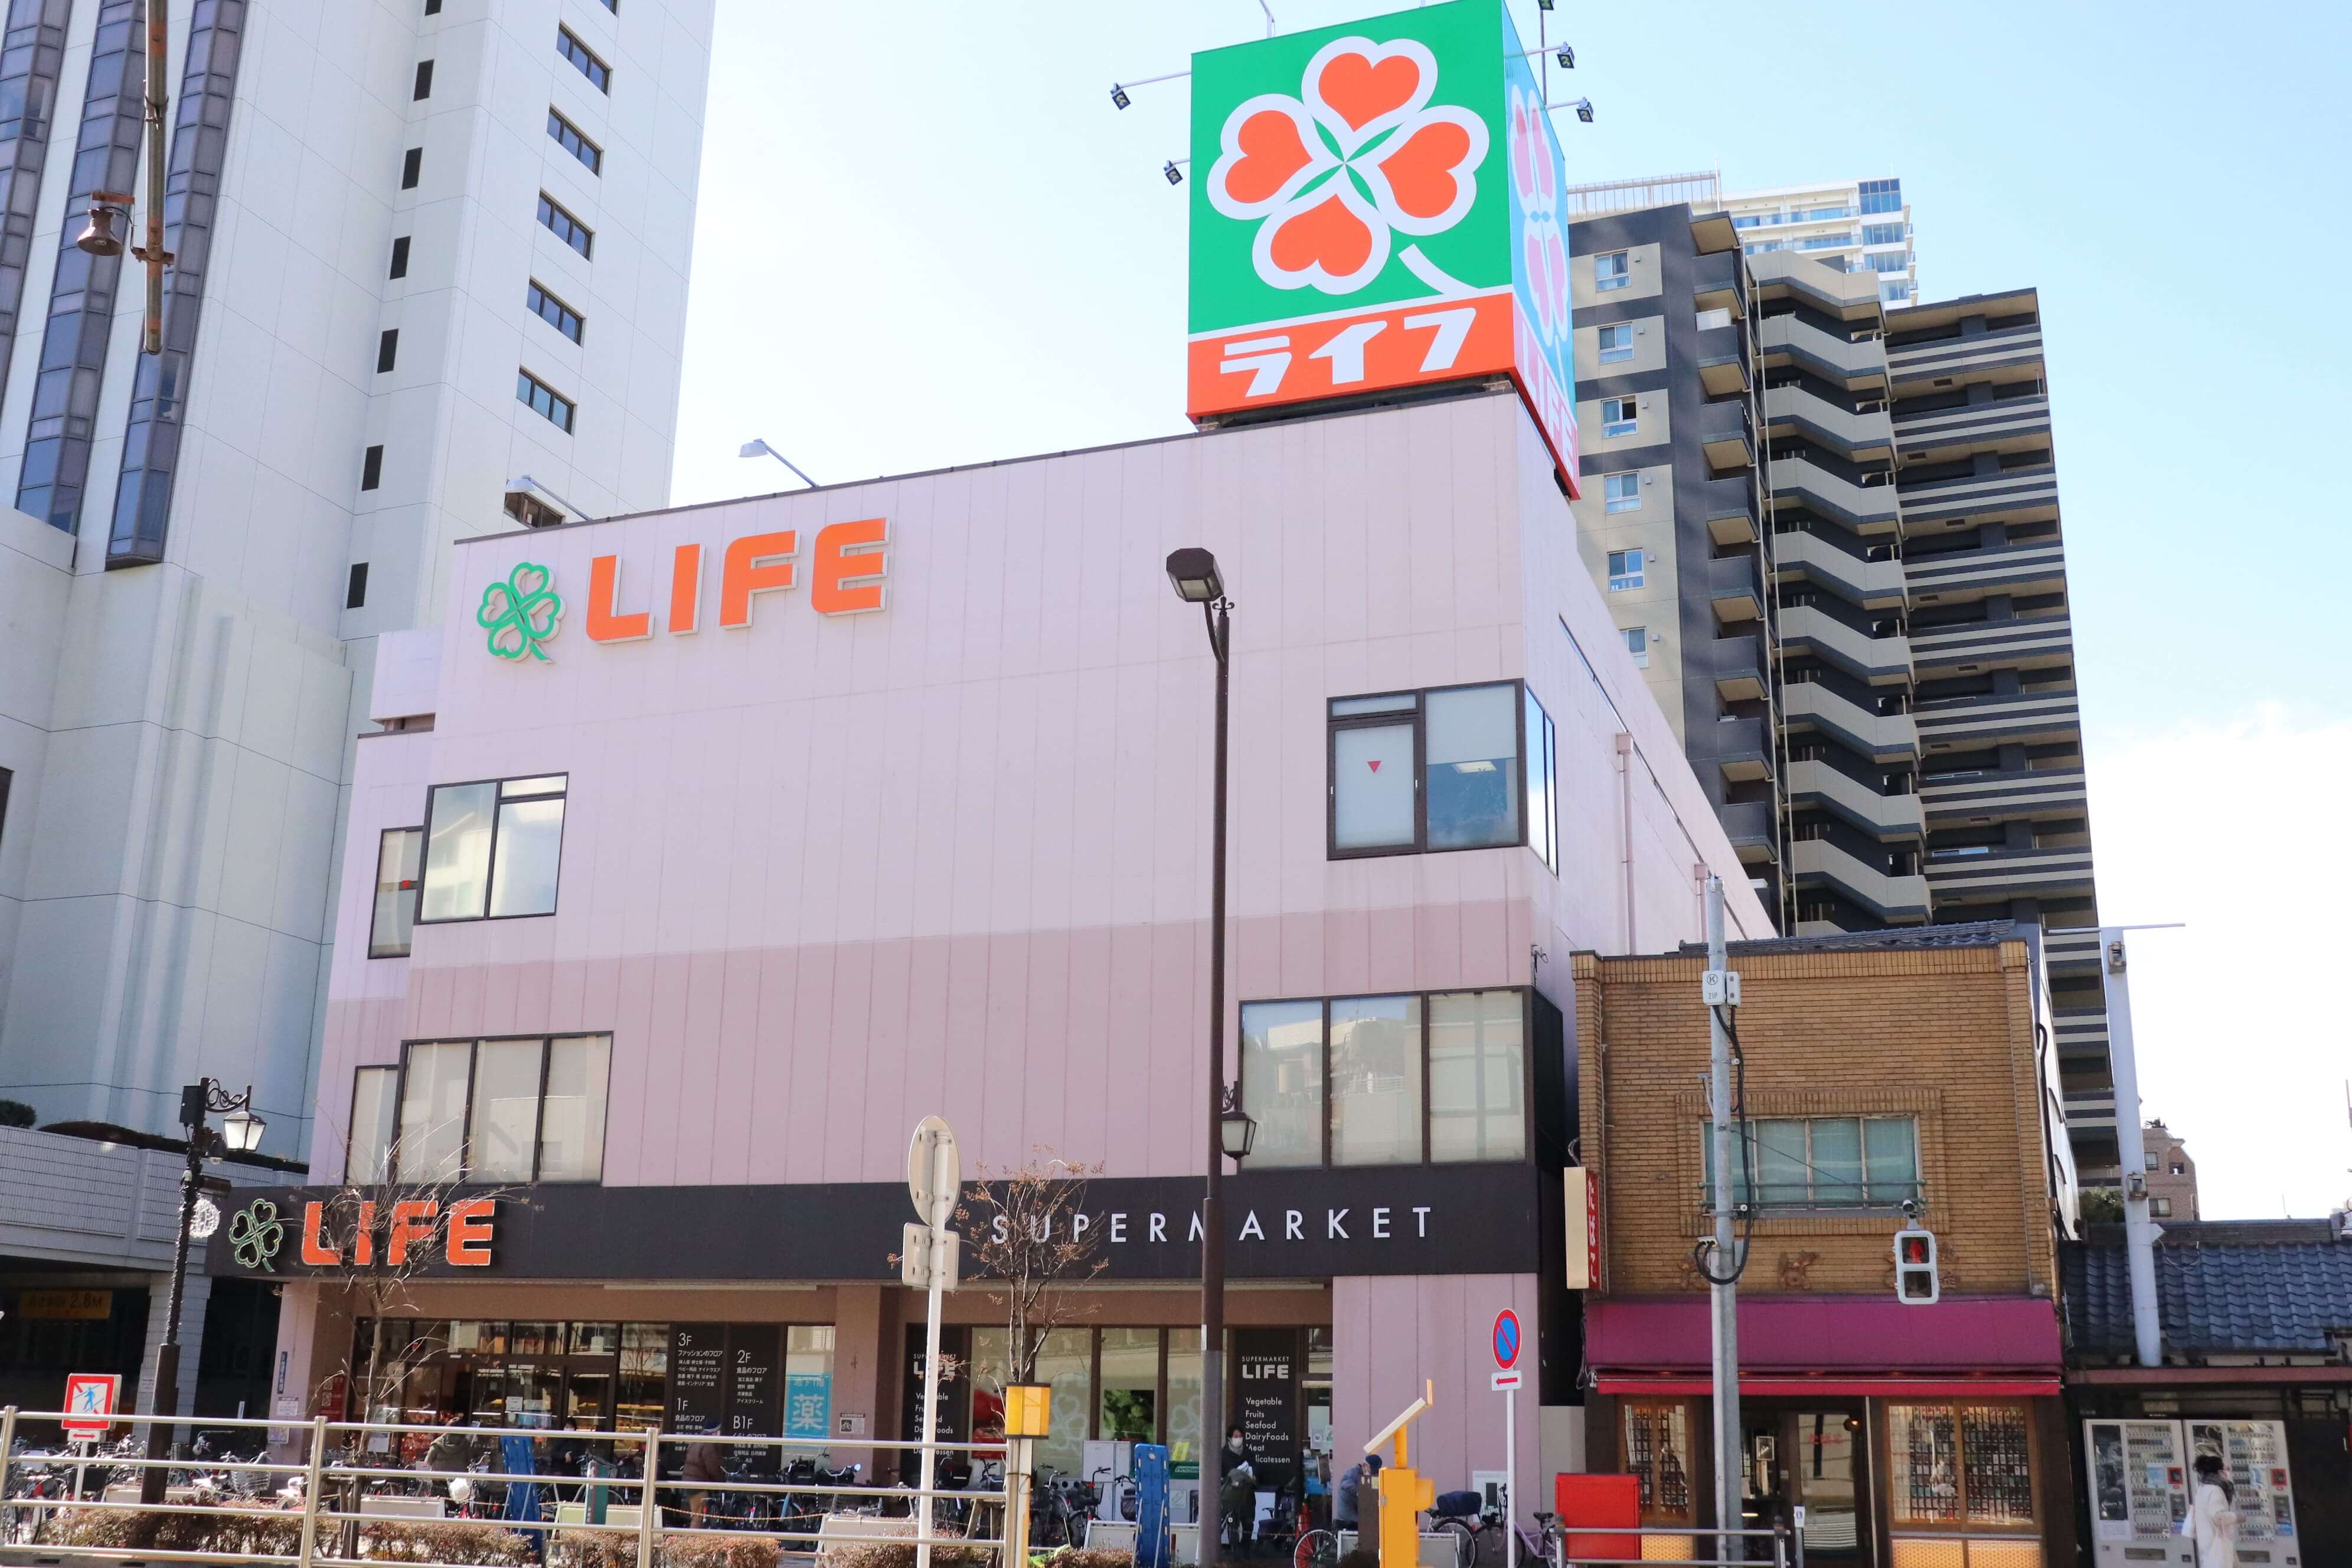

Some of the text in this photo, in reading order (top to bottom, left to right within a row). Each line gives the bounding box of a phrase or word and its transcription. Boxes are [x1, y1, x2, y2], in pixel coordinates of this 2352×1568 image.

[1220, 307, 1476, 398] ライフ
[1521, 320, 1574, 481] LIFE
[585, 517, 890, 645] LIFE
[301, 1199, 496, 1266] LIFE
[1587, 1176, 1597, 1283] たばこ
[678, 1332, 692, 1347] 3F
[737, 1350, 752, 1364] 2F
[1242, 1364, 1289, 1379] LIFE
[916, 1392, 949, 1400] Veble
[1246, 1397, 1282, 1407] Vegetable
[677, 1397, 689, 1411] 1F
[792, 1393, 825, 1430] 薬
[1245, 1410, 1265, 1418] Fruits
[733, 1415, 753, 1429] B1F
[1245, 1420, 1276, 1429] Seafood
[914, 1425, 953, 1434] Daoods
[1245, 1432, 1289, 1442] DairyFoods
[1255, 1454, 1290, 1464] licatessen
